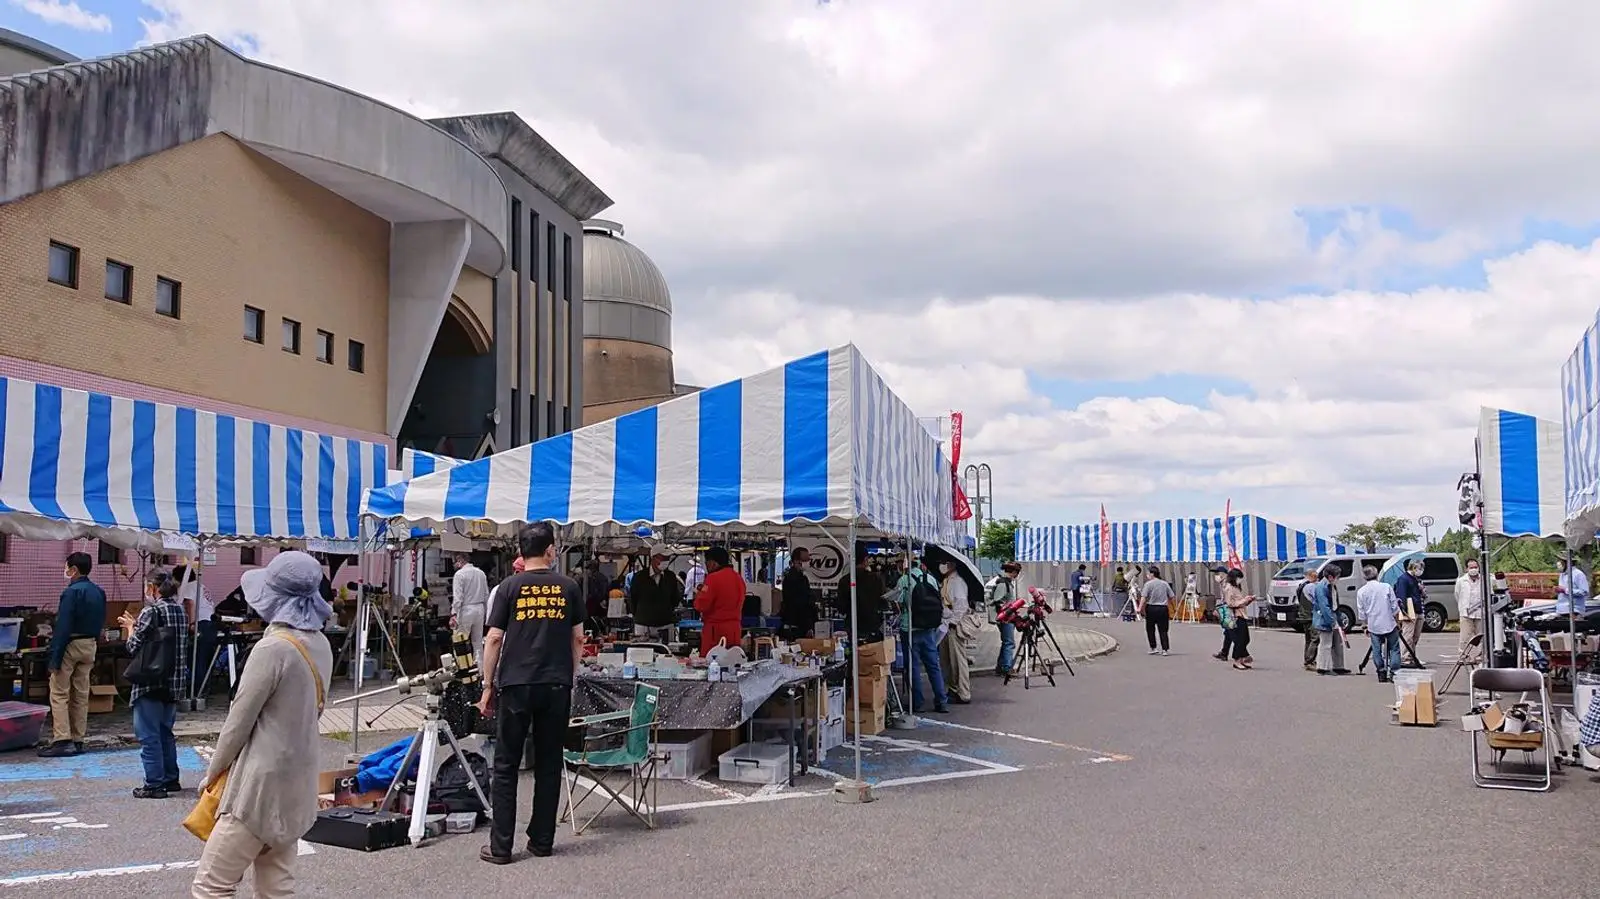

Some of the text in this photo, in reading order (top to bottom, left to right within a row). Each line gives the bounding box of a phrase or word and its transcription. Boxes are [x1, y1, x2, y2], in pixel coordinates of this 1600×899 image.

[520, 585, 561, 595] こちらは
[516, 609, 565, 620] ありません
